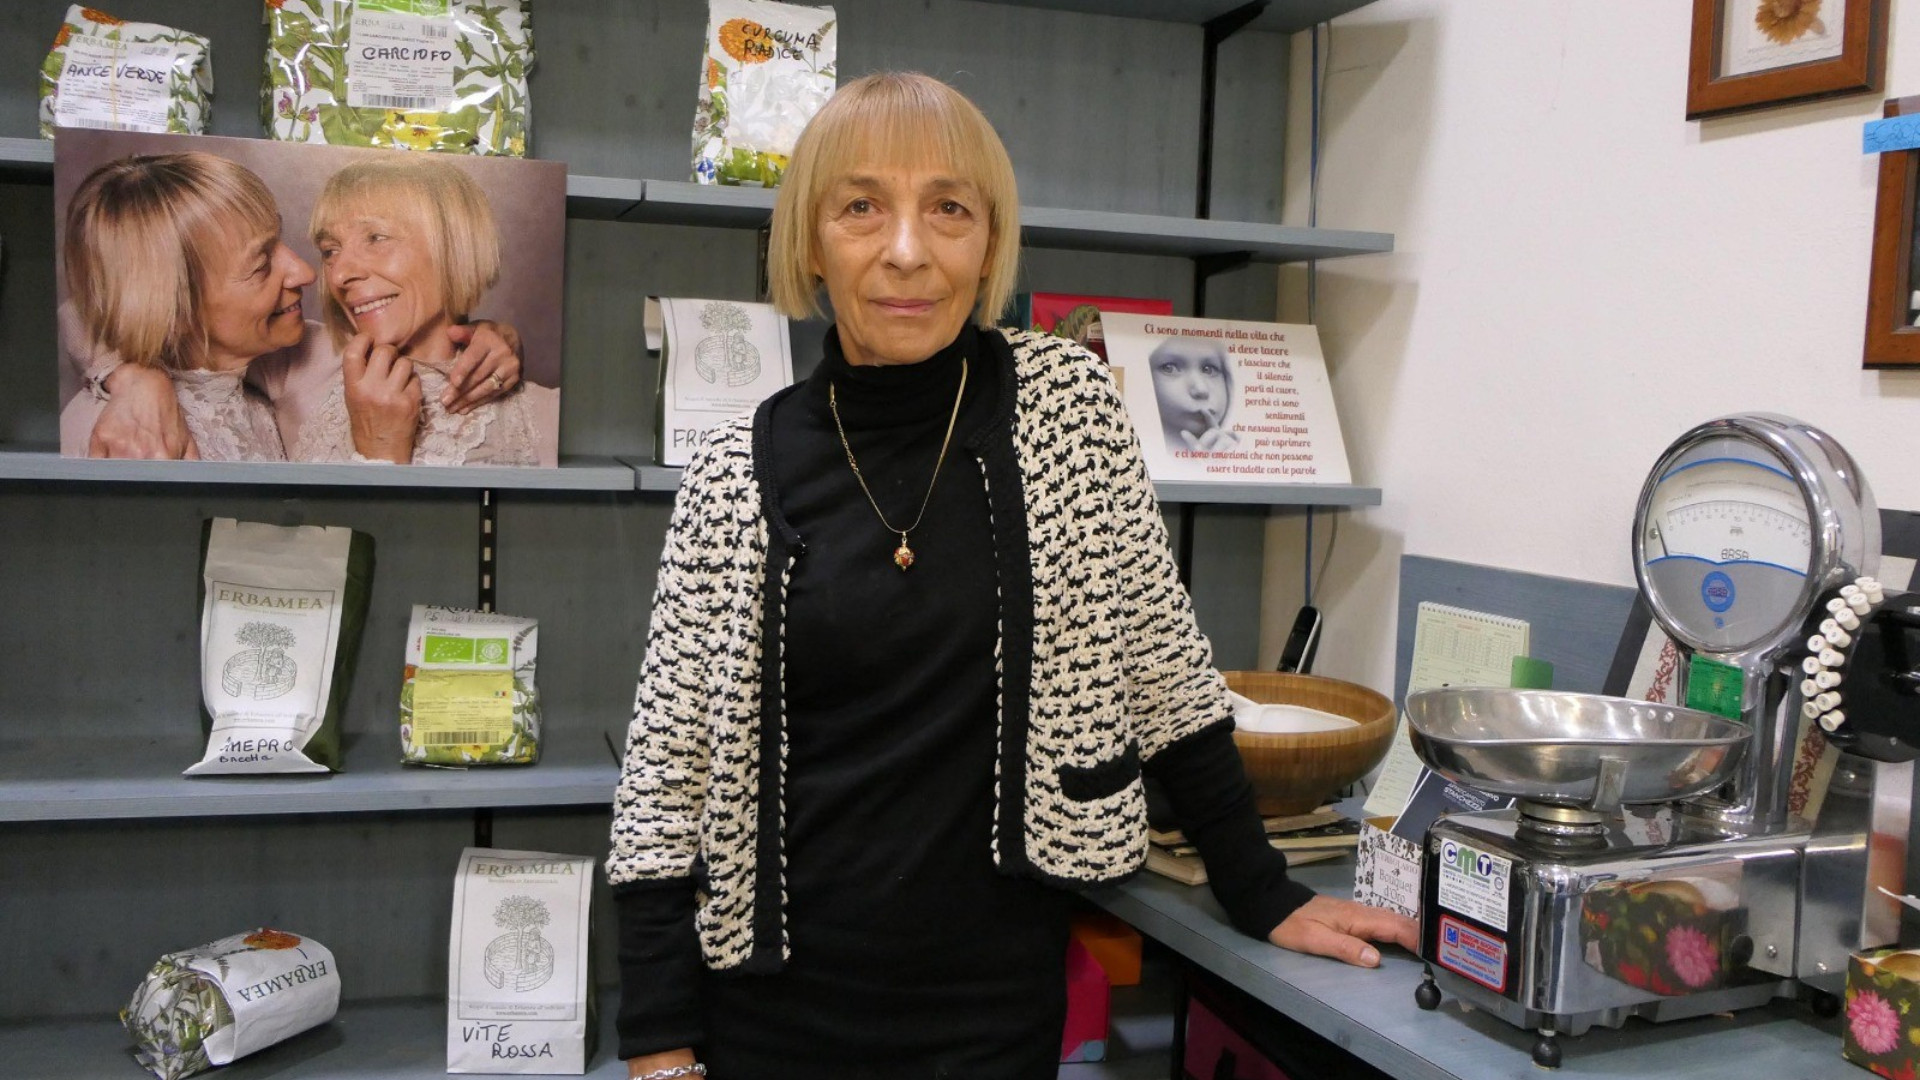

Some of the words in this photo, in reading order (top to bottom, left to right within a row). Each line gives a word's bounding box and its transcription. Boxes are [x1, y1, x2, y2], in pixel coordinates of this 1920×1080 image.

[741, 24, 817, 49] CURCUMA
[362, 46, 452, 62] CARCIOFO
[116, 63, 167, 84] VERDE
[1144, 324, 1153, 334] Ci
[1157, 326, 1178, 336] sono
[1181, 328, 1223, 338] momenti
[1225, 330, 1249, 340] nella
[1250, 331, 1268, 341] vita
[1269, 332, 1286, 342] che
[1227, 344, 1236, 354] si
[1237, 345, 1259, 355] deve
[1260, 346, 1289, 356] tacere
[1244, 358, 1276, 368] lasciare
[1278, 359, 1291, 369] che
[1264, 372, 1293, 381] silenzio
[1281, 400, 1300, 408] sono
[1265, 411, 1305, 421] sentimenti
[1232, 423, 1246, 432] che
[1271, 439, 1312, 449] esprimere
[1190, 451, 1209, 459] sono
[1211, 450, 1249, 460] emozioni
[1250, 451, 1264, 460] che
[1265, 453, 1280, 461] non
[1282, 453, 1314, 463] possono
[1206, 465, 1231, 473] essere
[1232, 464, 1265, 474] tradotte
[1266, 466, 1281, 474] con
[1290, 466, 1317, 477] parole
[219, 590, 323, 609] ERBAMEA
[475, 863, 576, 877] ERBAMEA
[237, 960, 328, 1003] ERBAMEA
[492, 1042, 553, 1059] ROSSA
